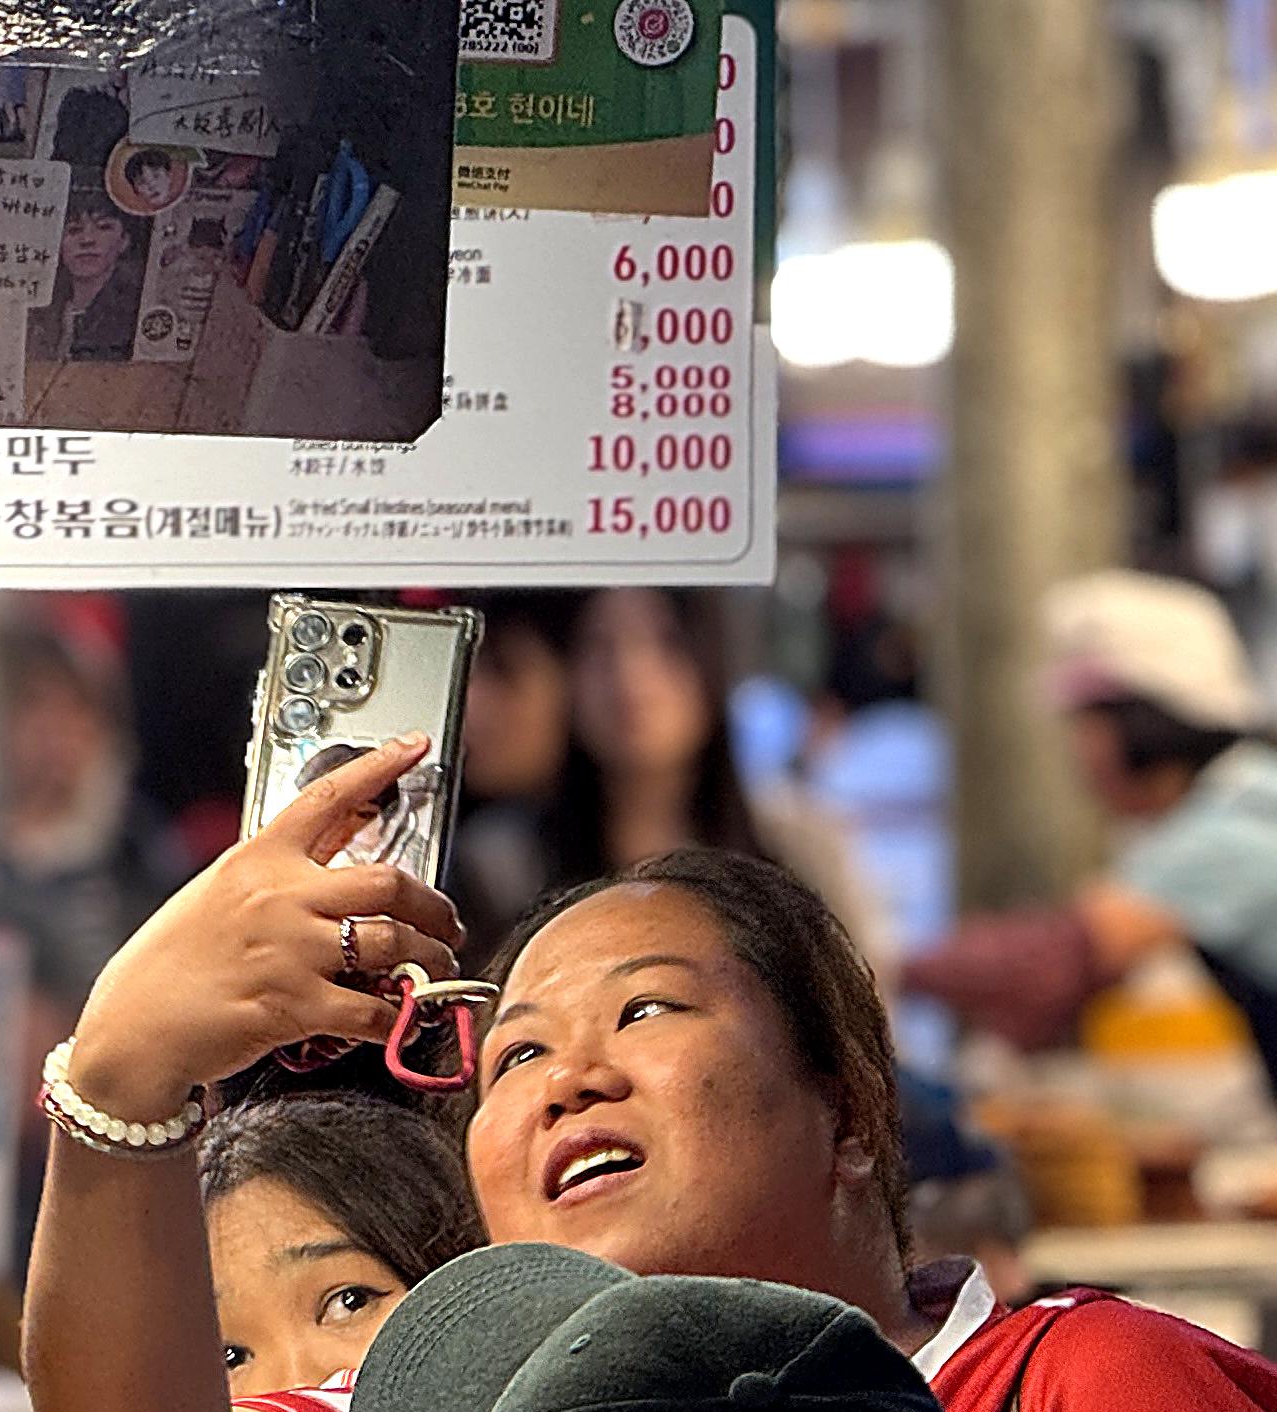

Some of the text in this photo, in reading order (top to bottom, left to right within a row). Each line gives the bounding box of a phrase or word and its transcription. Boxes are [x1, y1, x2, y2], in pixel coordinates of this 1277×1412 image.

[510, 93, 595, 128] 현이네
[613, 243, 735, 287] 6,000
[610, 363, 732, 394] 5,000
[610, 393, 732, 422] 8,000
[587, 434, 733, 477] 10,000
[586, 495, 733, 540] 15,000
